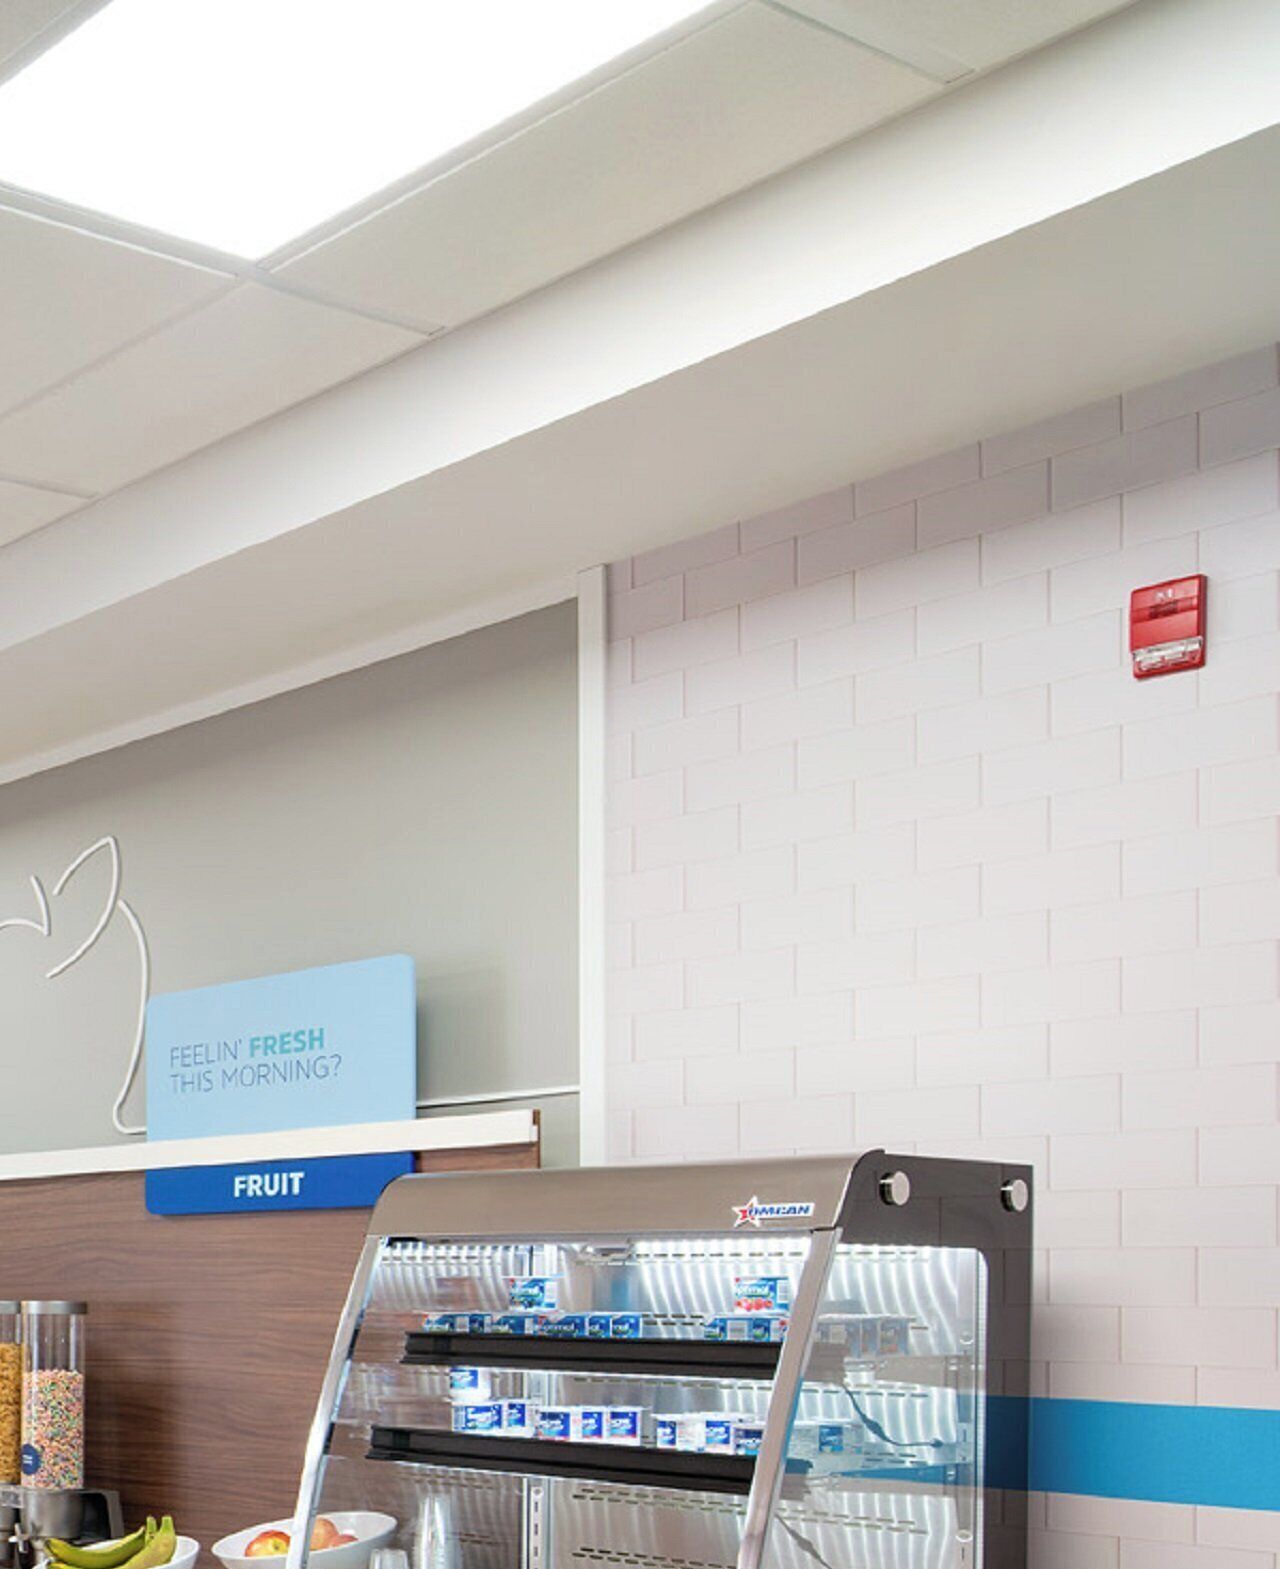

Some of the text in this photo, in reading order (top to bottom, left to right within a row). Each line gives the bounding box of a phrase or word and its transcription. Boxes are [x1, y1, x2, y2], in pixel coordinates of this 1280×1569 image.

[170, 1027, 325, 1069] FEELIN' FRESH
[170, 1053, 343, 1094] THIS MORNING?
[233, 1171, 306, 1198] FRUIT
